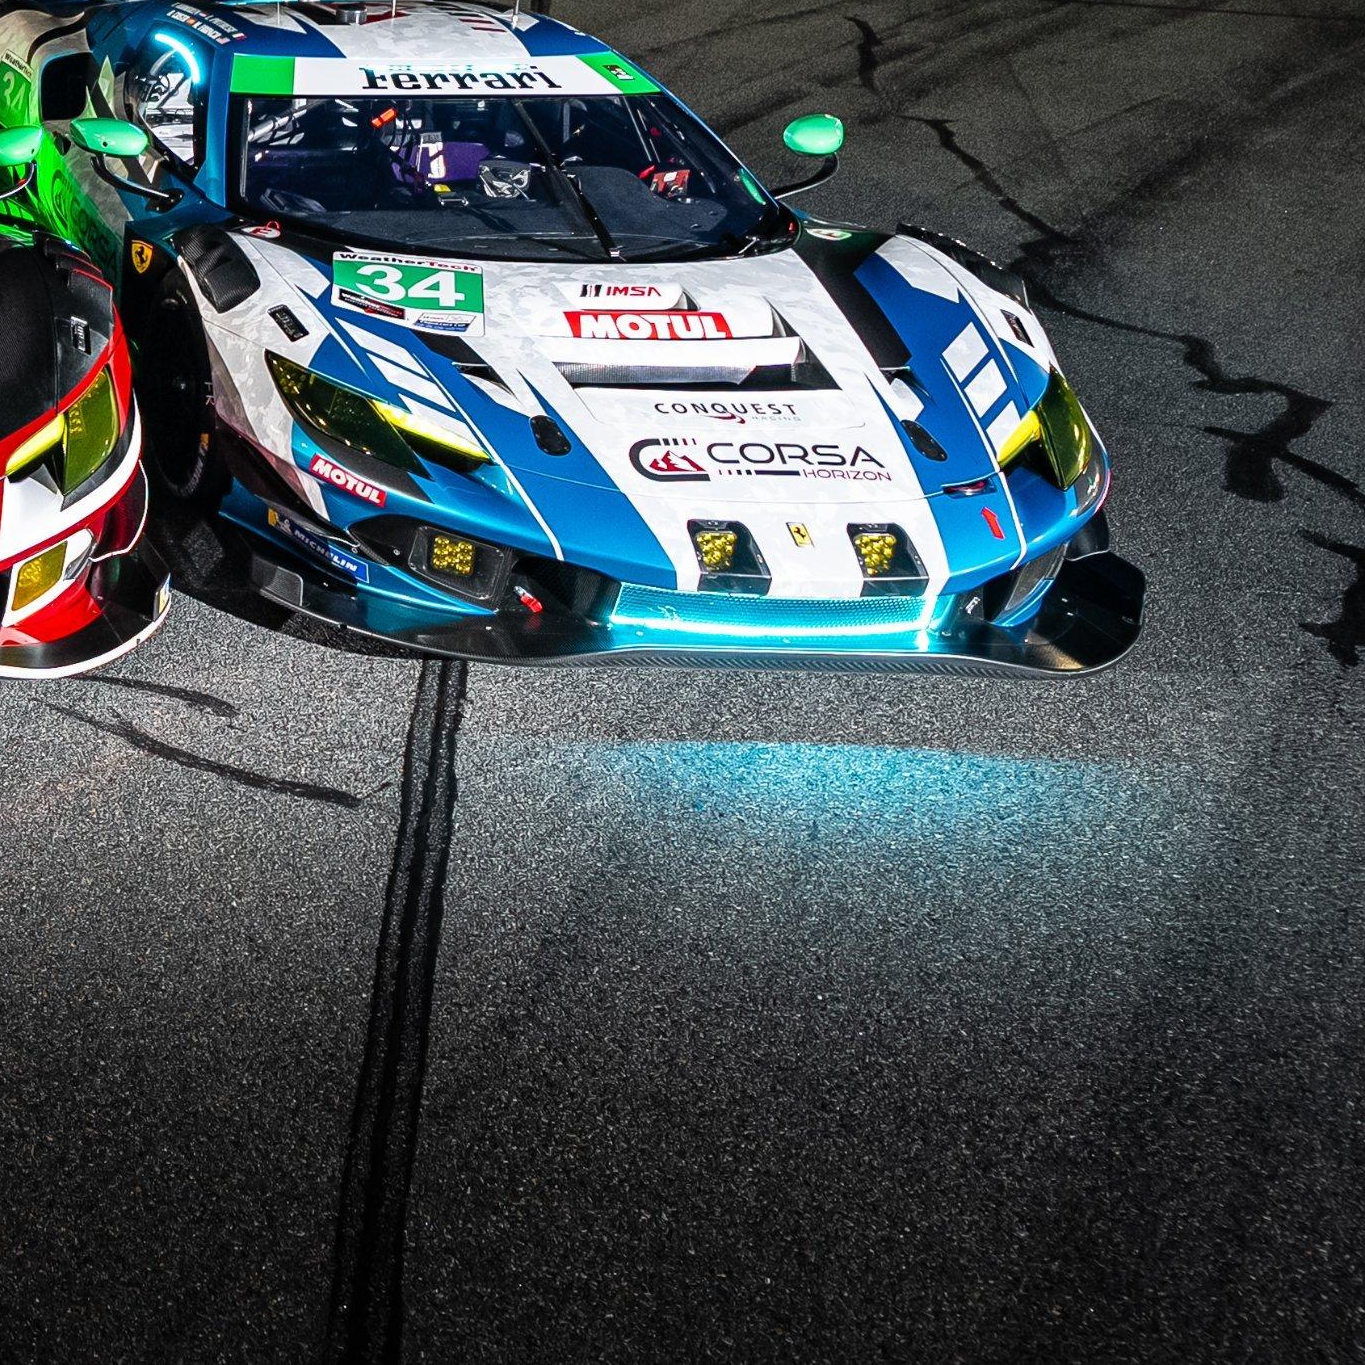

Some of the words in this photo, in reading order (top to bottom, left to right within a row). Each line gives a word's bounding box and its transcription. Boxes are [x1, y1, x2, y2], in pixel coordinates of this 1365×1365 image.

[2, 70, 27, 111] 34
[339, 253, 478, 272] WeatherTech
[355, 265, 465, 307] 34
[606, 286, 662, 296] IMSA
[579, 314, 727, 340] MOTUL
[654, 403, 798, 417] CONQUEST
[706, 442, 886, 469] CORSA
[312, 457, 382, 504] MOTUL
[803, 468, 892, 482] HORIZON
